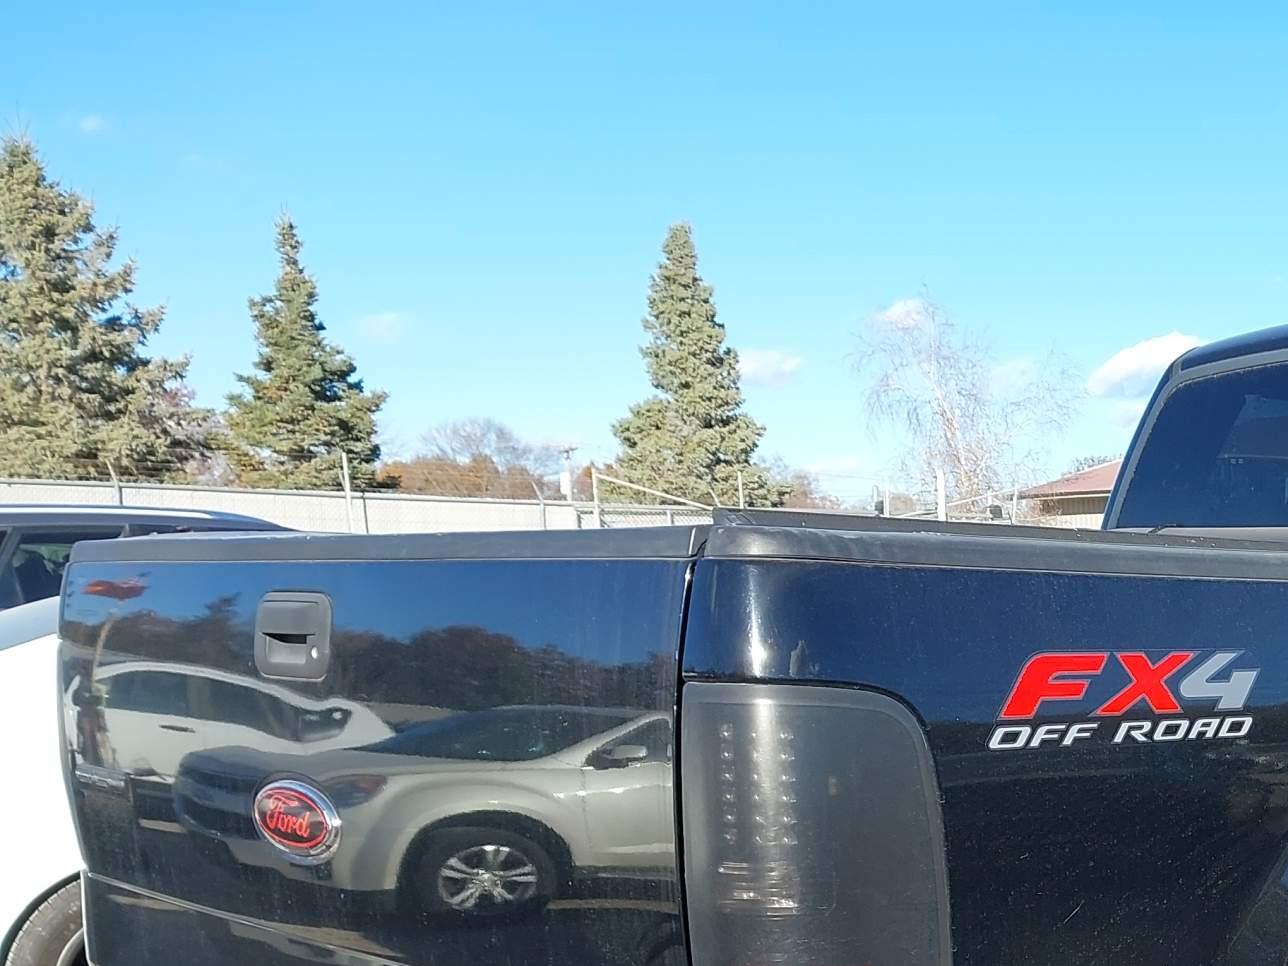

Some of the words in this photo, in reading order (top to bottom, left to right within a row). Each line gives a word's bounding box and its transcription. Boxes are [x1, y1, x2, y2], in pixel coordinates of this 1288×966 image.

[996, 650, 1260, 720] FX4
[987, 721, 1099, 751] OFF
[1112, 716, 1254, 745] ROAD
[266, 795, 312, 838] Ford
